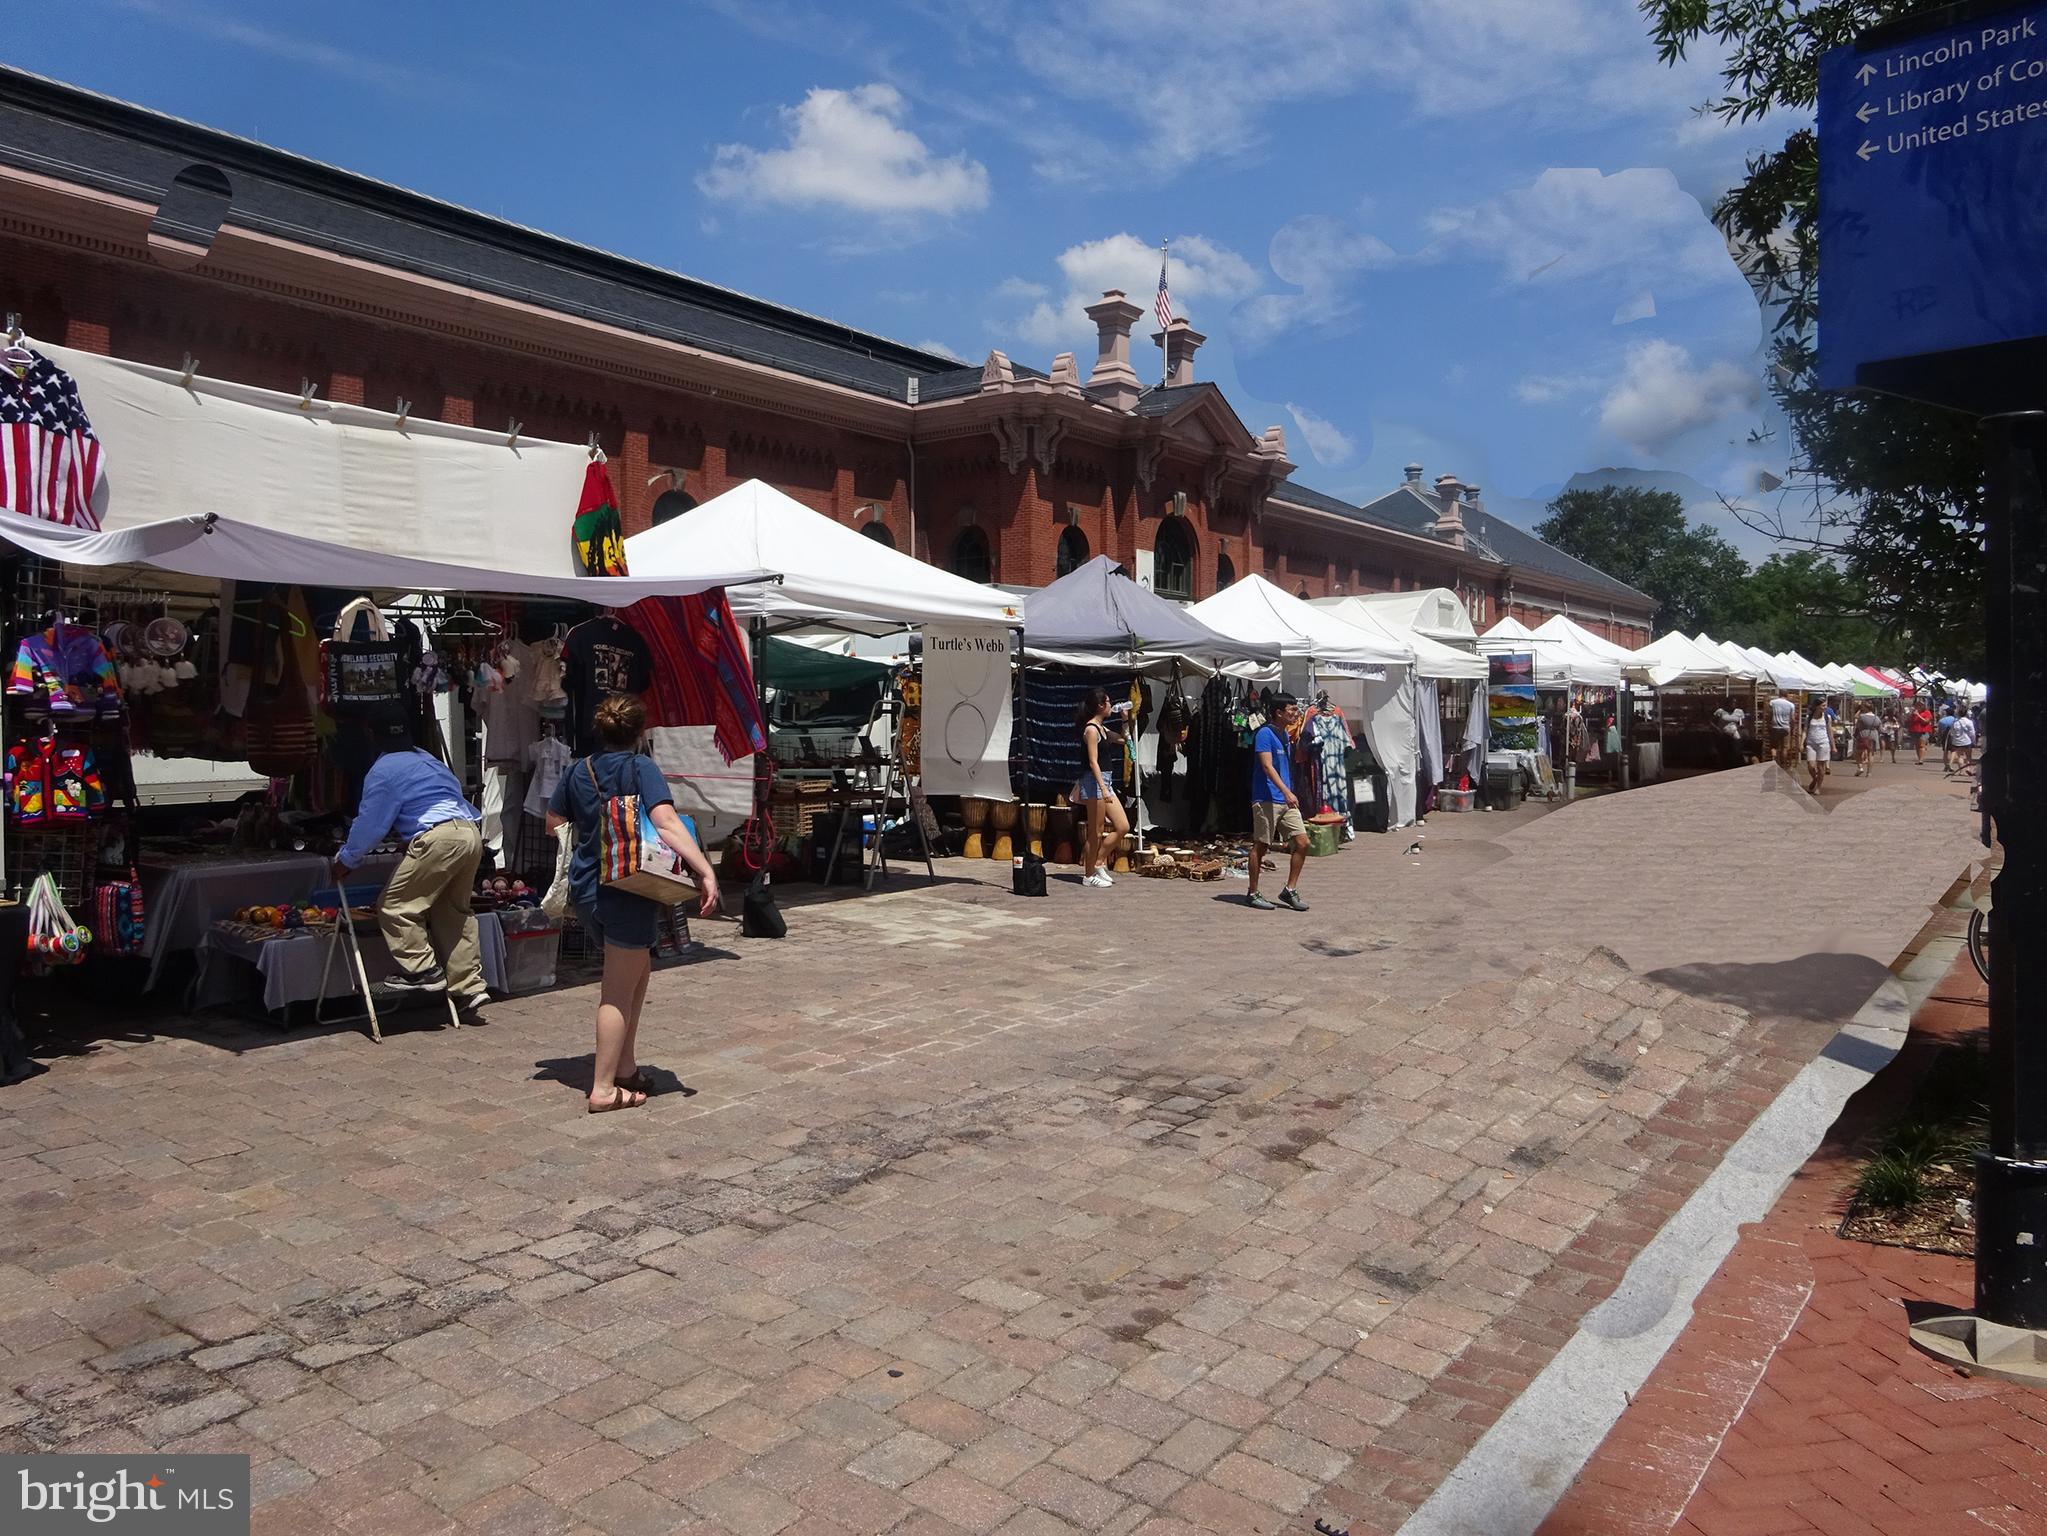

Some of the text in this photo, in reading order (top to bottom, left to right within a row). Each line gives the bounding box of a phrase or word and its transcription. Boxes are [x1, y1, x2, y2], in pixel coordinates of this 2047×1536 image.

[1886, 17, 2037, 78] Lincoln Park
[1887, 58, 2047, 116] Library of Co
[1887, 115, 1968, 154] United
[929, 636, 1004, 653] Turtle's Webb
